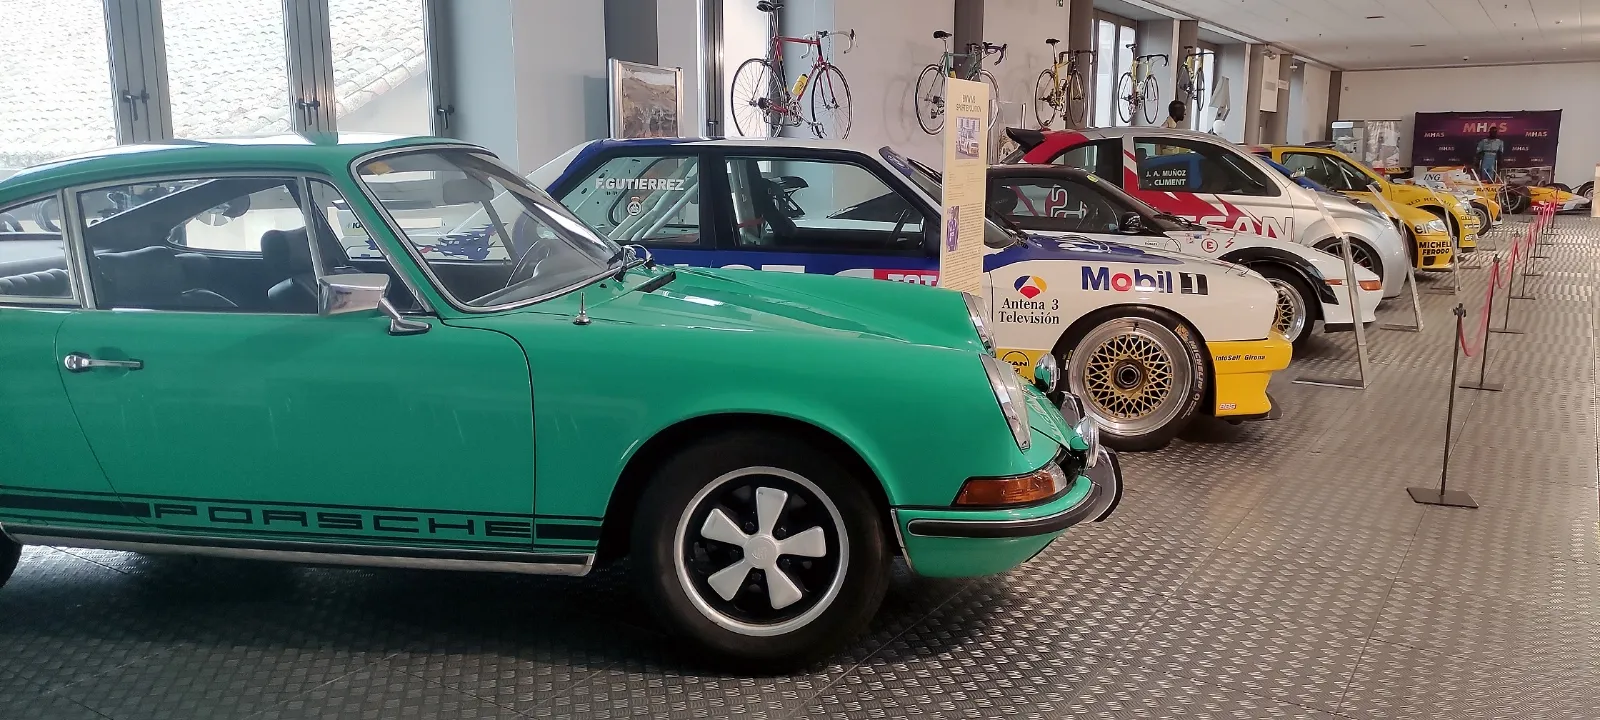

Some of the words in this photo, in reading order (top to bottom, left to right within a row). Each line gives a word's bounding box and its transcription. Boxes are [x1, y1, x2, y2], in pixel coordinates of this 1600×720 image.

[1162, 168, 1187, 177] MUÑOZ
[1423, 173, 1441, 181] ING
[595, 178, 685, 191] F.GUTIERREZ
[1153, 178, 1187, 186] CLIMENT
[1206, 241, 1214, 249] E
[1081, 266, 1174, 294] Mobil
[1001, 298, 1045, 310] Antena
[1051, 299, 1059, 310] 3
[998, 311, 1060, 325] Televisión
[1188, 340, 1204, 390] MICHELIN
[154, 502, 532, 538] PORSCHE
